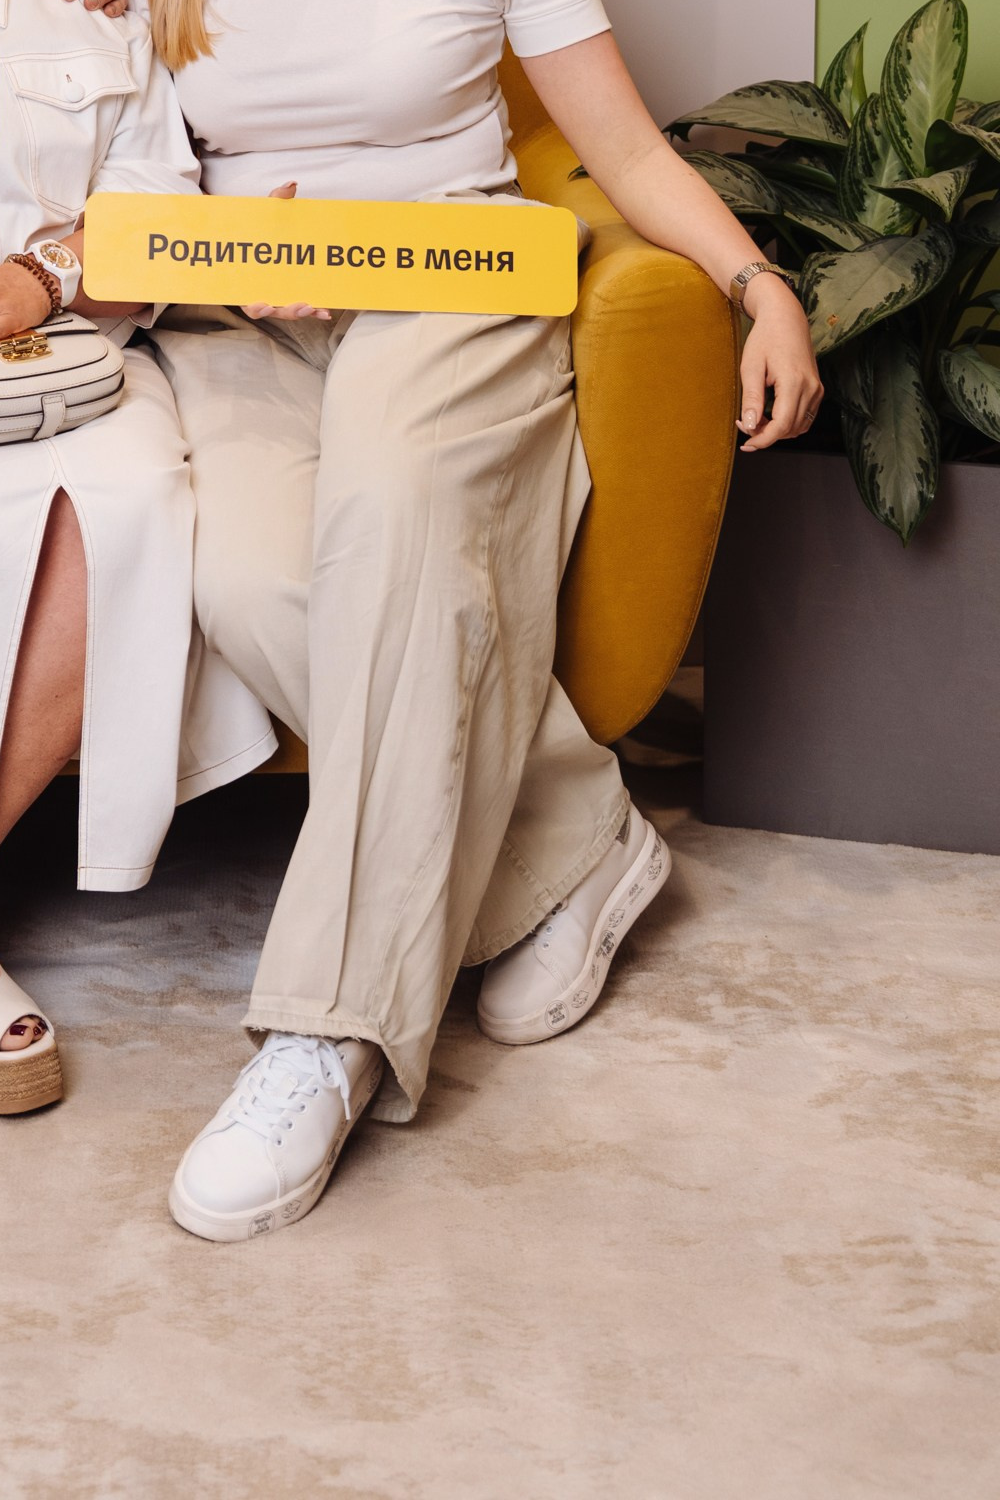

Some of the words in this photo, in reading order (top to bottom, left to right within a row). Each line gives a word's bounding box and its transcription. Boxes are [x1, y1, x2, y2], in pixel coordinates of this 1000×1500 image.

[147, 232, 316, 267] Родители
[326, 244, 387, 269] все
[396, 247, 416, 269] в
[424, 248, 515, 272] меня
